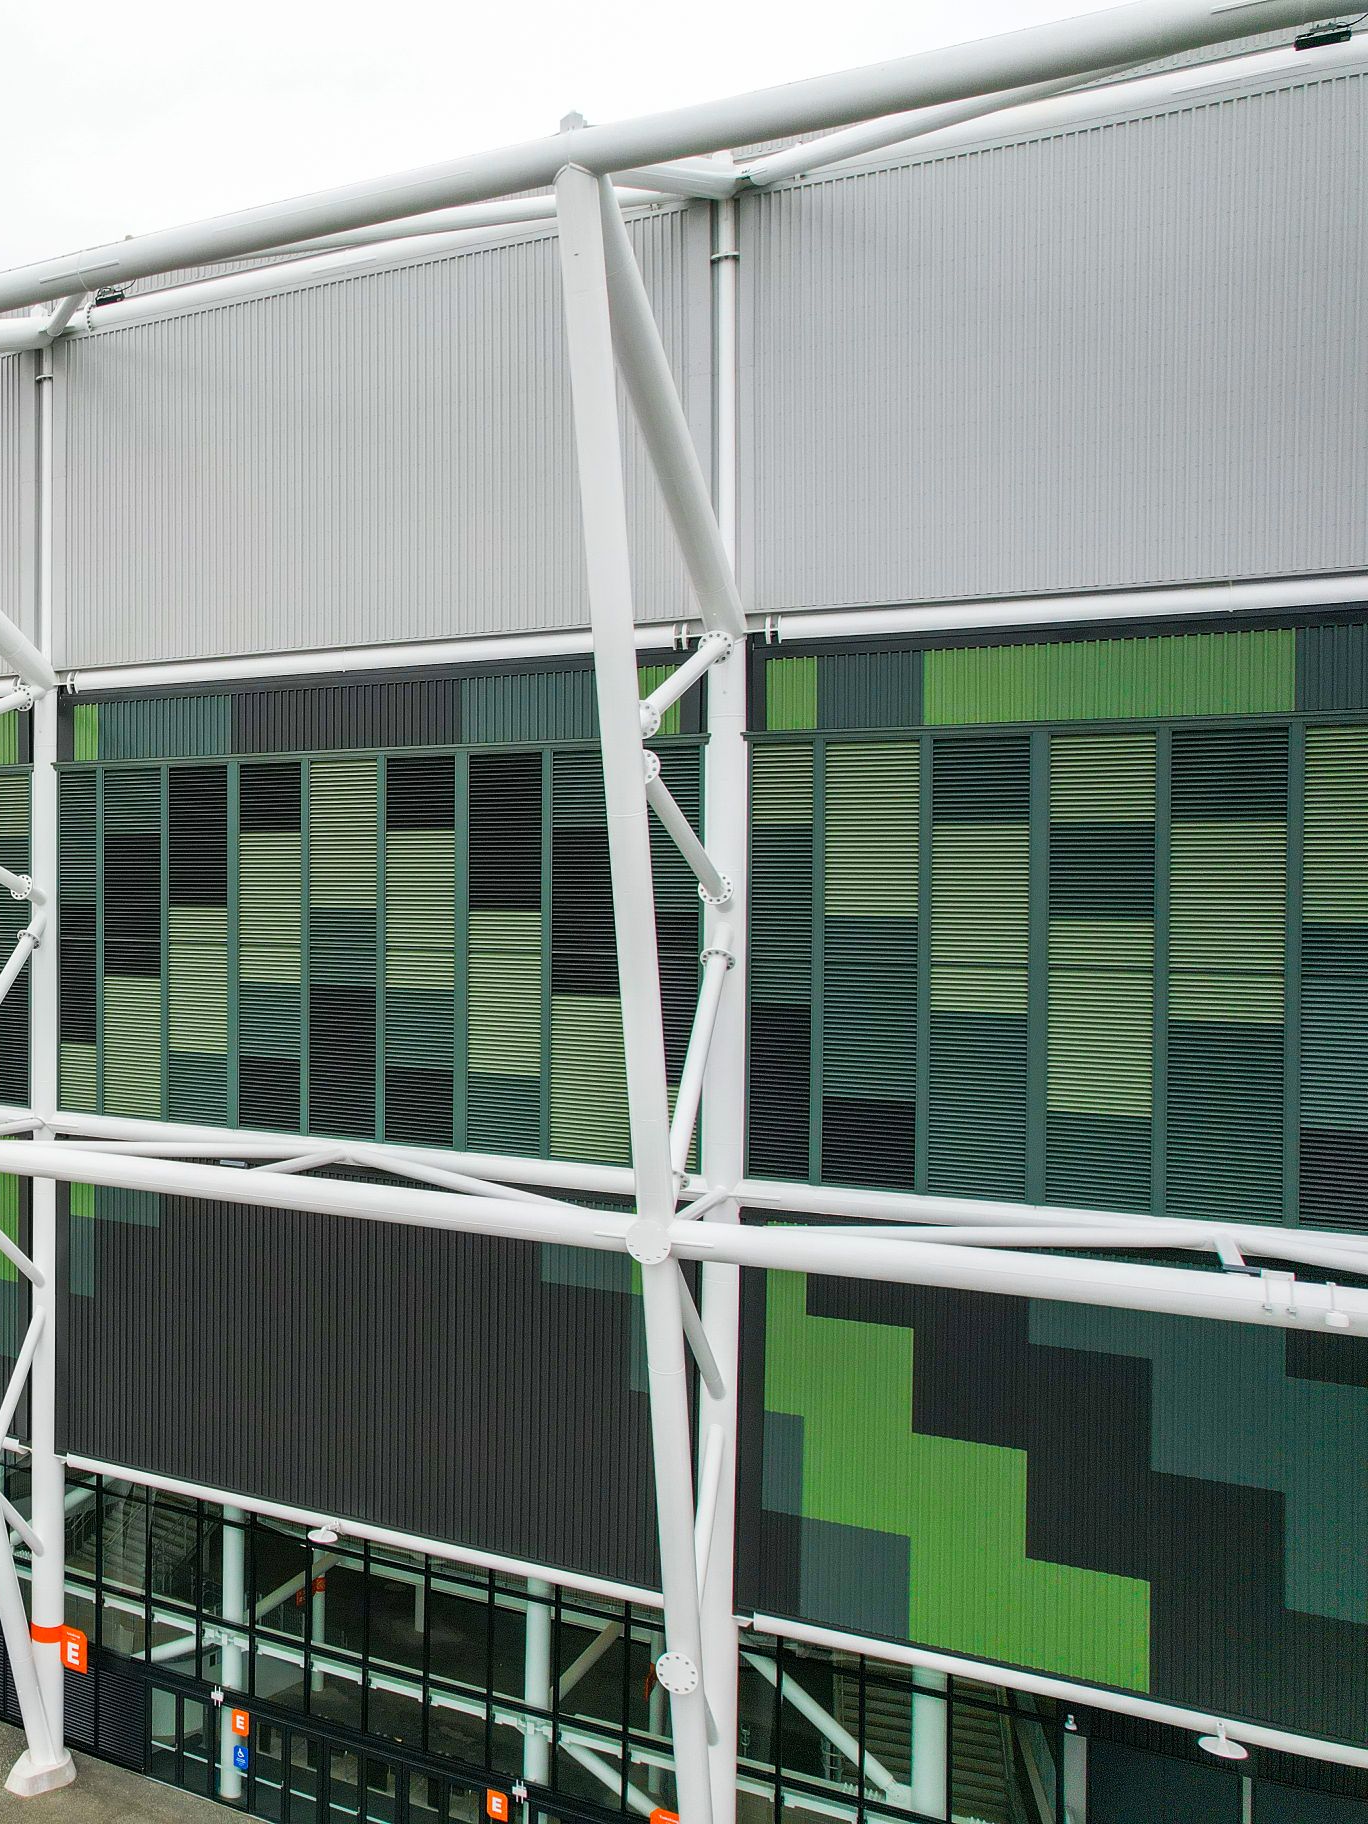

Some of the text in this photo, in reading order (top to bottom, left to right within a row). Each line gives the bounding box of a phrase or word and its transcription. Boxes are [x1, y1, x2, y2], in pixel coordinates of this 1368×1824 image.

[67, 1641, 79, 1665] E
[236, 1715, 244, 1730] E
[492, 1796, 502, 1813] E
